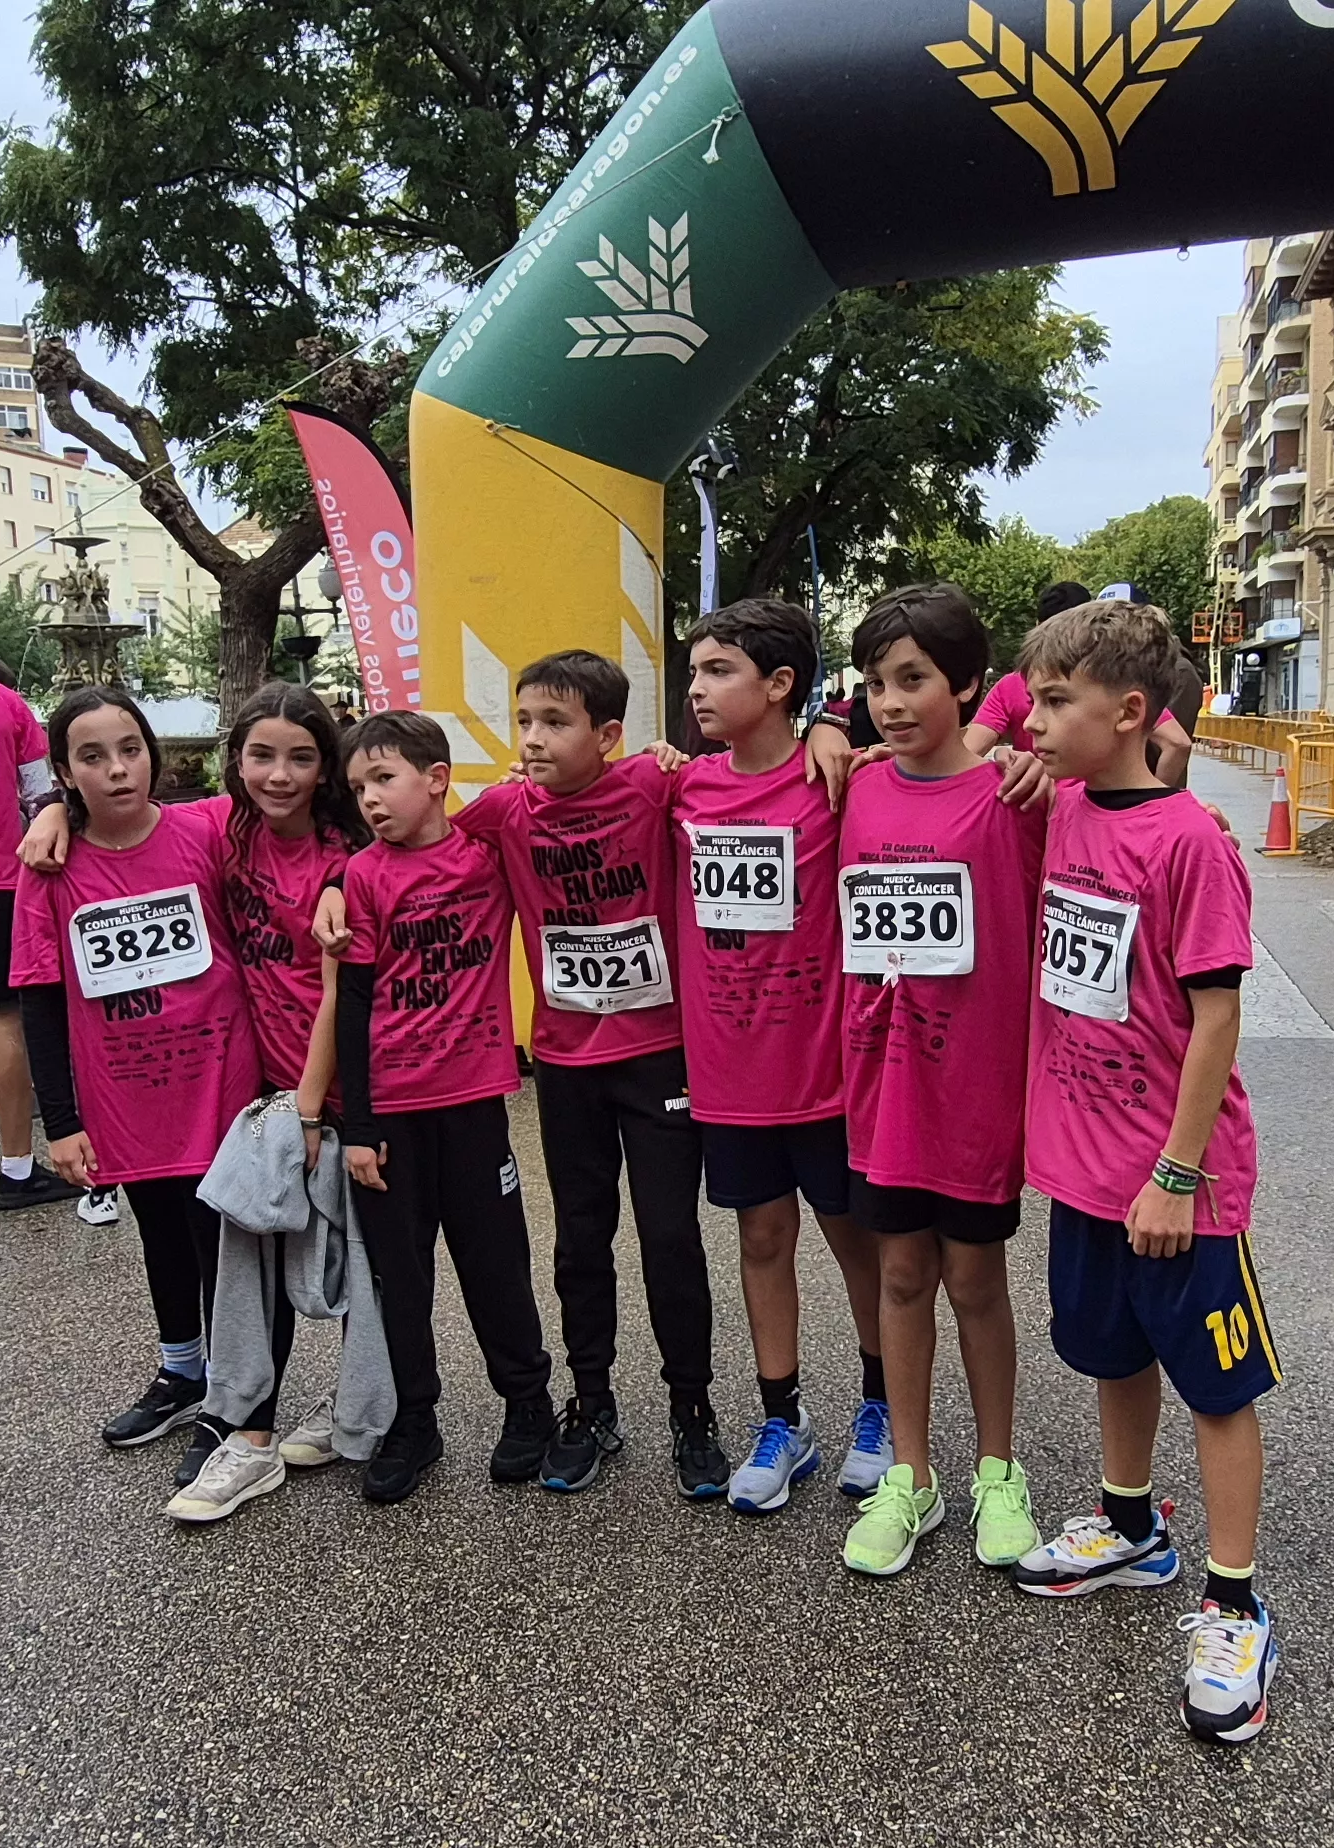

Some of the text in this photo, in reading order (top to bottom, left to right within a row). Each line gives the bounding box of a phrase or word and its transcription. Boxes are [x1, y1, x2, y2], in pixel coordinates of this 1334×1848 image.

[435, 42, 700, 379] cajaruraldearagon.es
[711, 837, 741, 845] HUESCA
[721, 845, 733, 856] EL
[734, 843, 778, 856] CÁNCER
[561, 860, 648, 906] EN CADA
[692, 860, 779, 900] 3048
[854, 881, 956, 896] CONTRA EL CÁNCER
[883, 875, 916, 884] HUESCA
[84, 903, 188, 932] CONTRA EL CÁNCER
[119, 904, 151, 915] HUESCA
[852, 900, 958, 942] 3830
[1077, 914, 1117, 936] CÁNCER
[87, 918, 196, 969] 3828
[554, 934, 648, 952] CONTRA EL CÁNCER
[1042, 920, 1114, 983] 3057
[420, 949, 446, 976] EN
[555, 949, 653, 988] 3021
[390, 974, 449, 1011] PASO
[1205, 1302, 1250, 1371] 10
